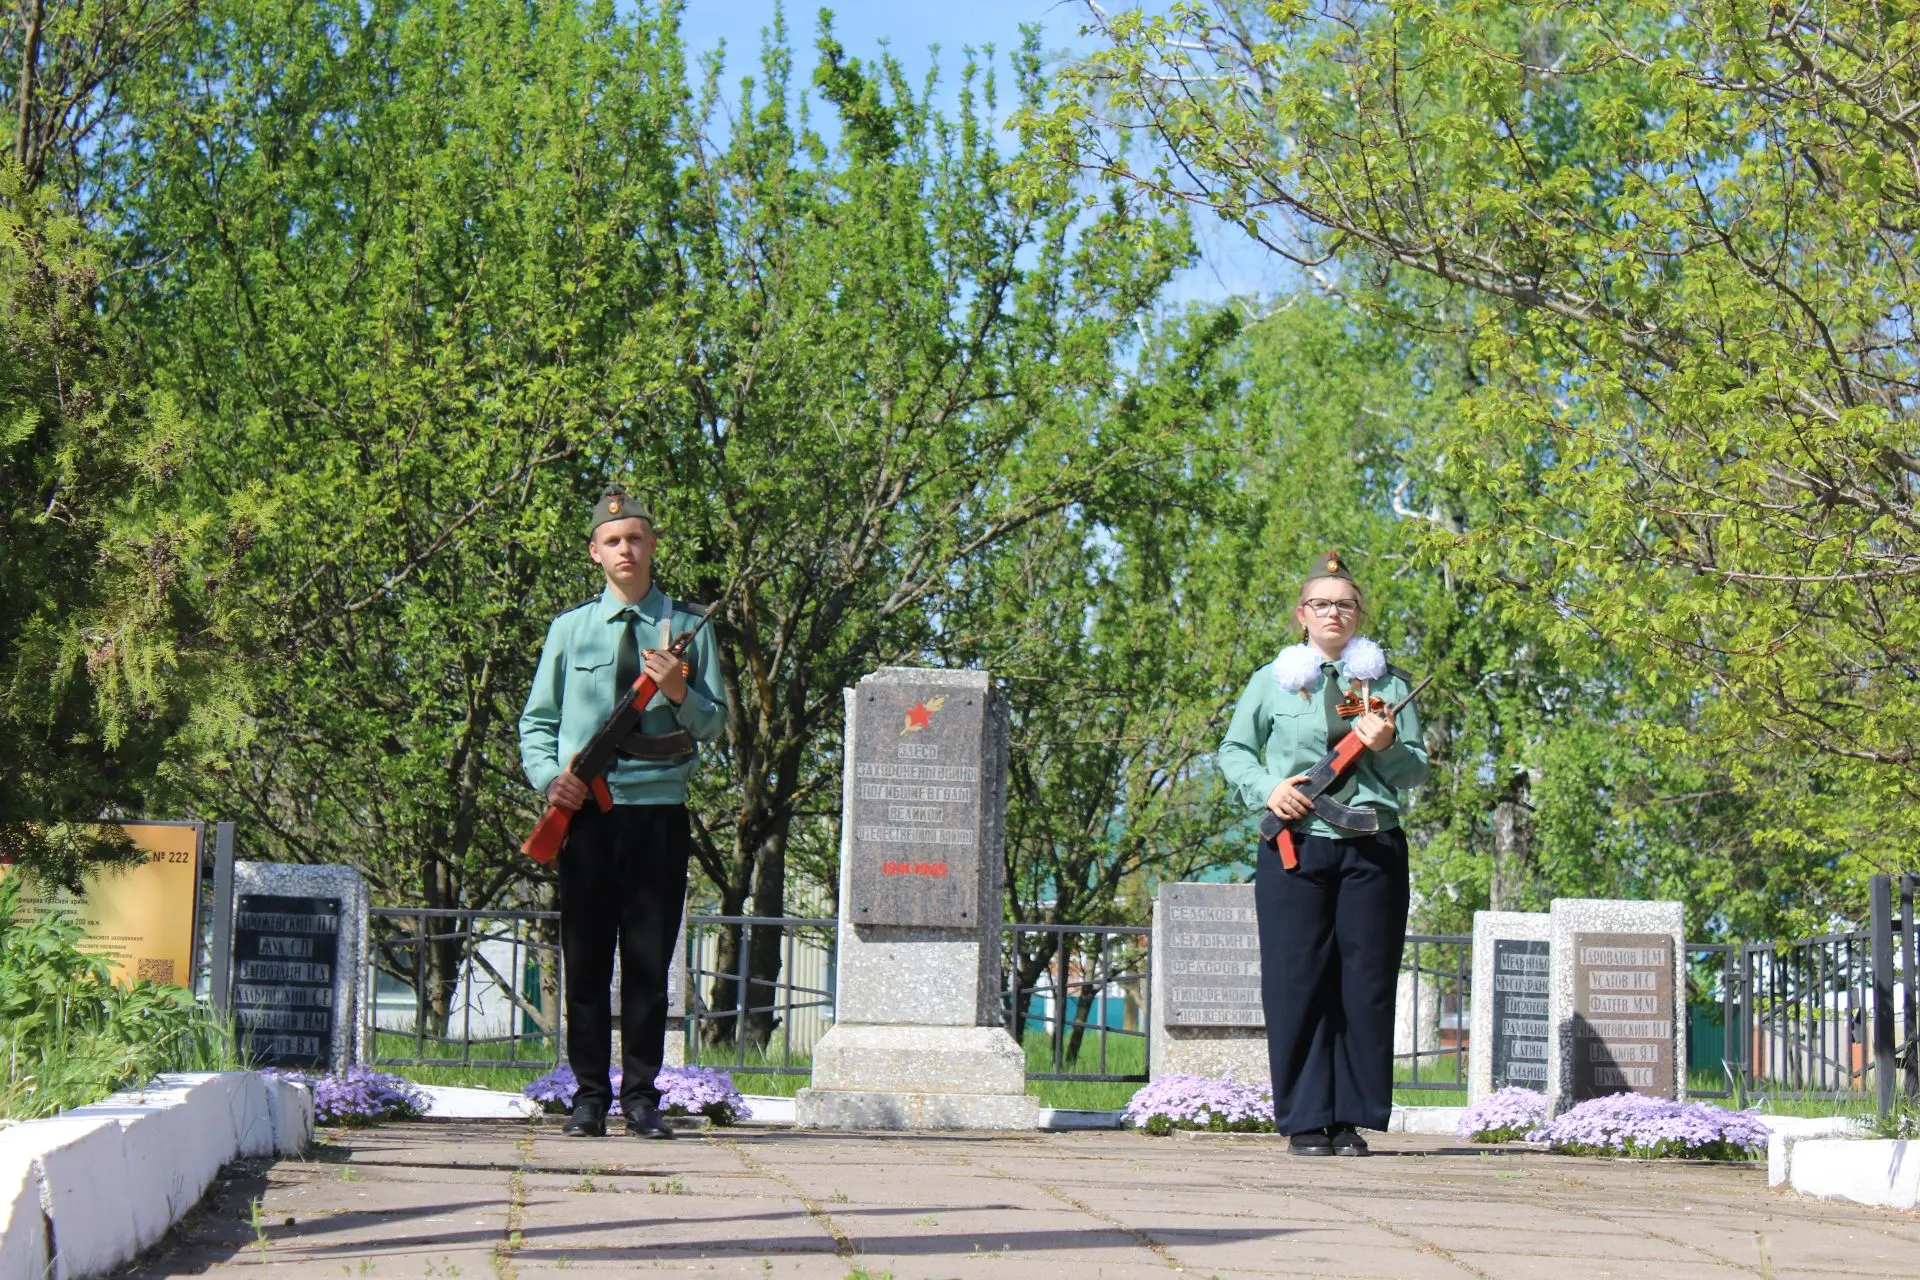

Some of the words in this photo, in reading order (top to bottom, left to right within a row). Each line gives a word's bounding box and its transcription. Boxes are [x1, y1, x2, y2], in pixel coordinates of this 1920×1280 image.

[153, 852, 165, 862] №
[168, 852, 189, 864] 222
[1591, 972, 1628, 989] УСАТОВ
[1591, 995, 1629, 1012] ФАТЕЕВ
